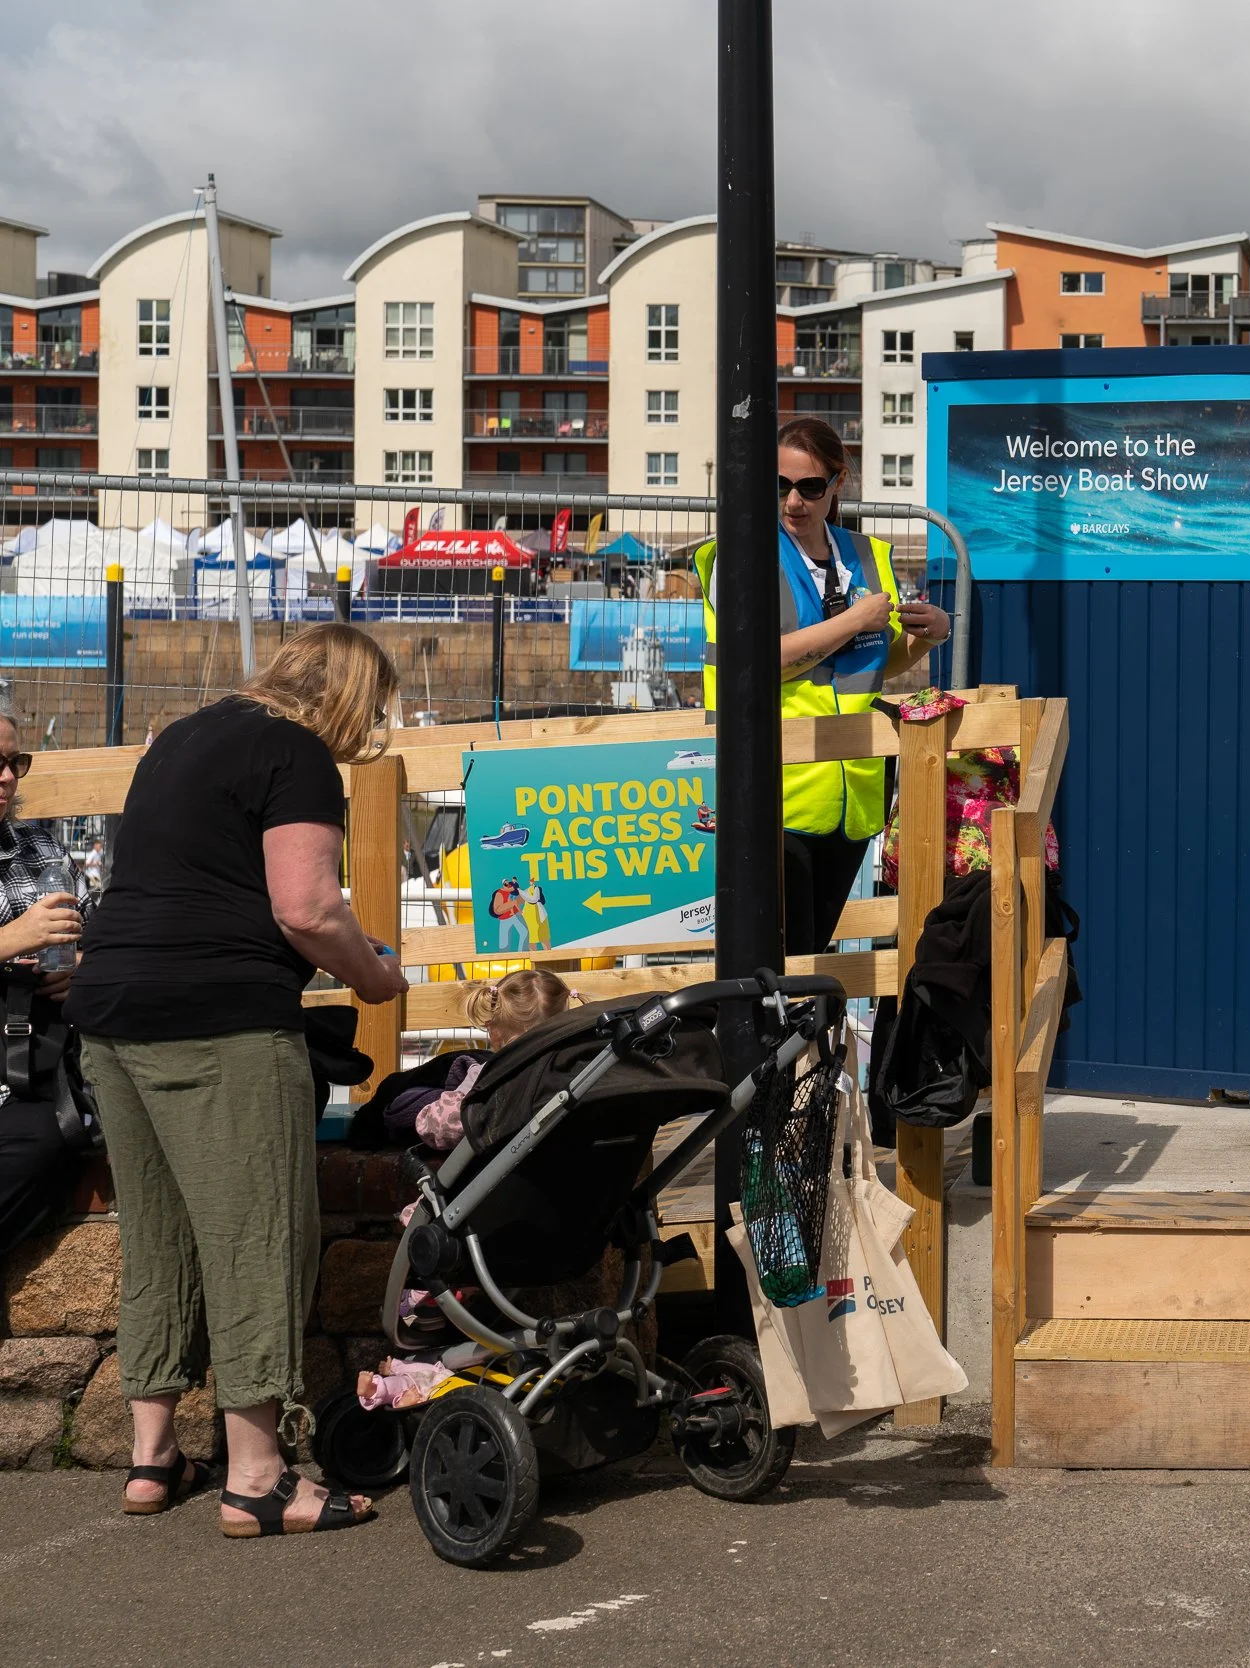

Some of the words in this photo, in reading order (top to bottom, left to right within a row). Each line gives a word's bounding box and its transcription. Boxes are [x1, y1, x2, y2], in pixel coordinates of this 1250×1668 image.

[1006, 435, 1118, 459] Welcome
[1123, 436, 1150, 457] to
[1154, 433, 1196, 457] the
[993, 468, 1073, 498] Jersey
[1078, 468, 1135, 492] Boat
[1140, 466, 1209, 491] Show
[1082, 523, 1130, 534] BARCLAYS
[414, 540, 482, 553] BULL
[400, 558, 452, 567] OUTDOOR
[455, 558, 508, 567] KITCHENS
[28, 631, 50, 641] deep
[515, 776, 704, 816] PONTOON
[541, 811, 683, 848] ACCESS
[520, 848, 608, 882] THIS
[614, 842, 706, 878] WAY
[680, 904, 711, 923] Jersey
[697, 915, 711, 925] BOAT
